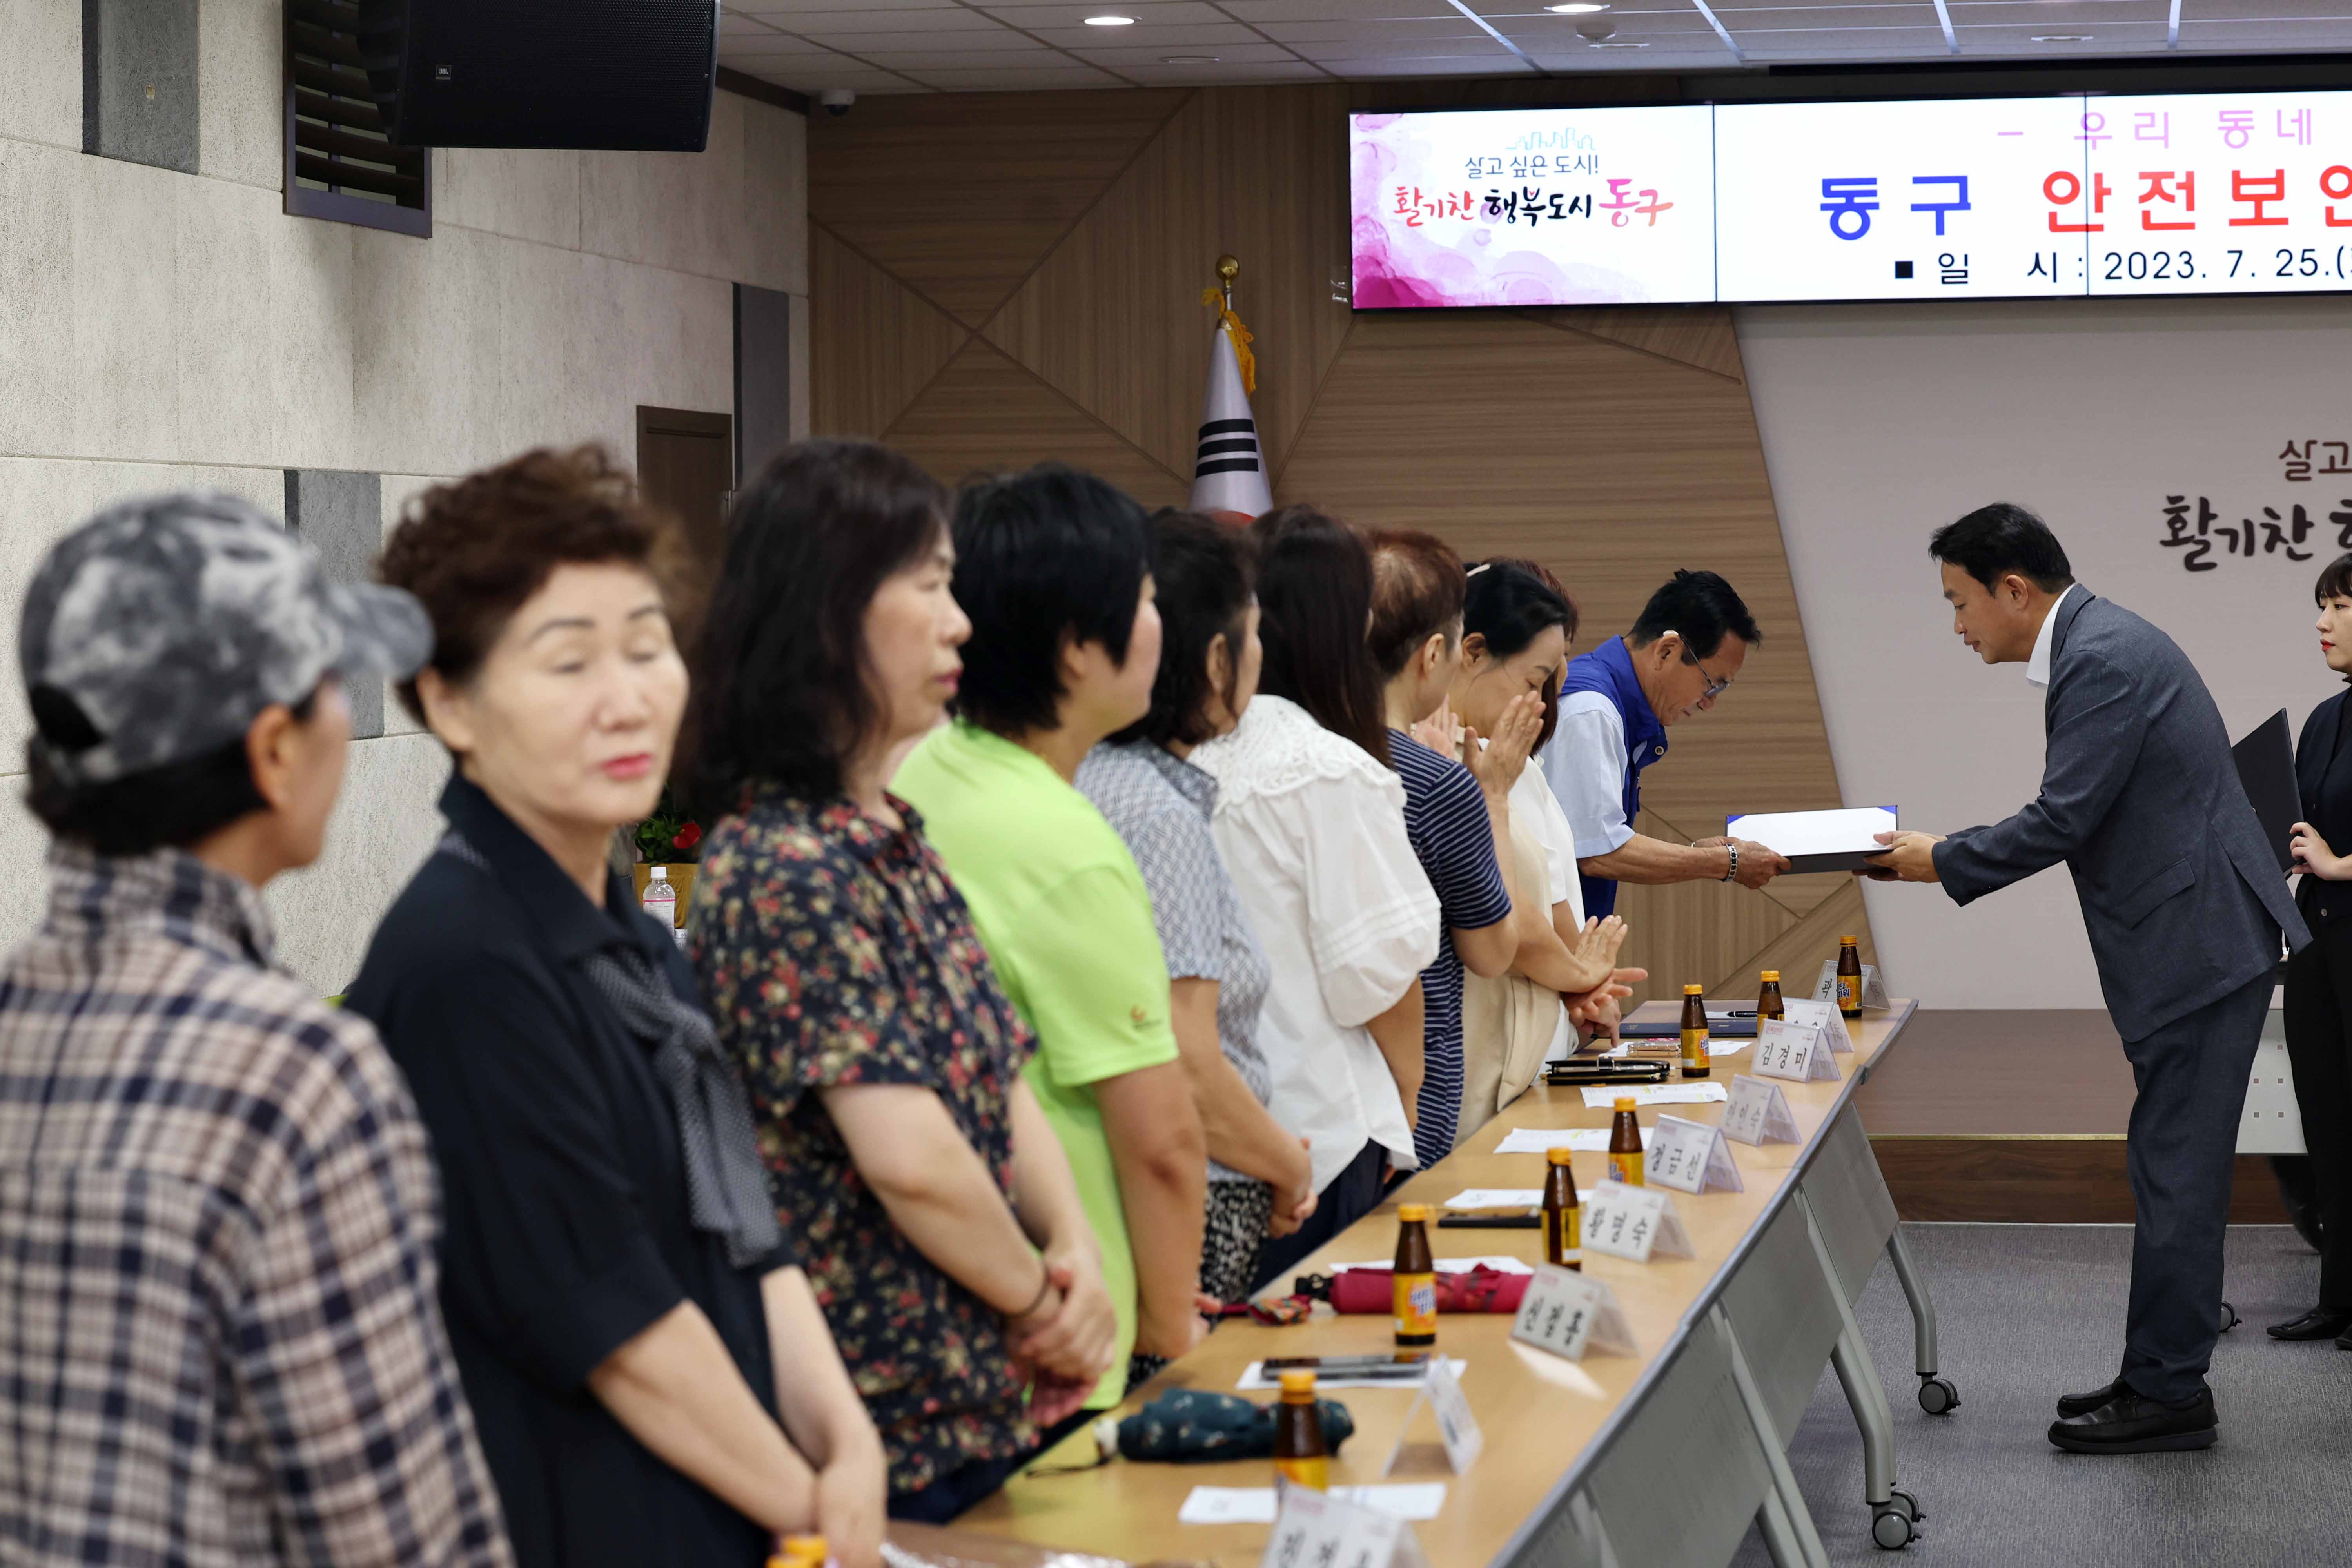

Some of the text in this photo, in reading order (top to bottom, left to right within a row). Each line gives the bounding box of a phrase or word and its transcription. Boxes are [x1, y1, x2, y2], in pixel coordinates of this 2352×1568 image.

[2074, 112, 2169, 150] 우리
[2218, 108, 2312, 149] 동네
[1465, 154, 1599, 179] 살고 싶은 도시!
[1394, 178, 1674, 227] 활기찬 행복도시 동구
[1820, 175, 1971, 241] 동구
[2279, 439, 2352, 482] 살고
[2159, 495, 2315, 572] 활기찬
[1762, 1042, 1807, 1072] 김경미
